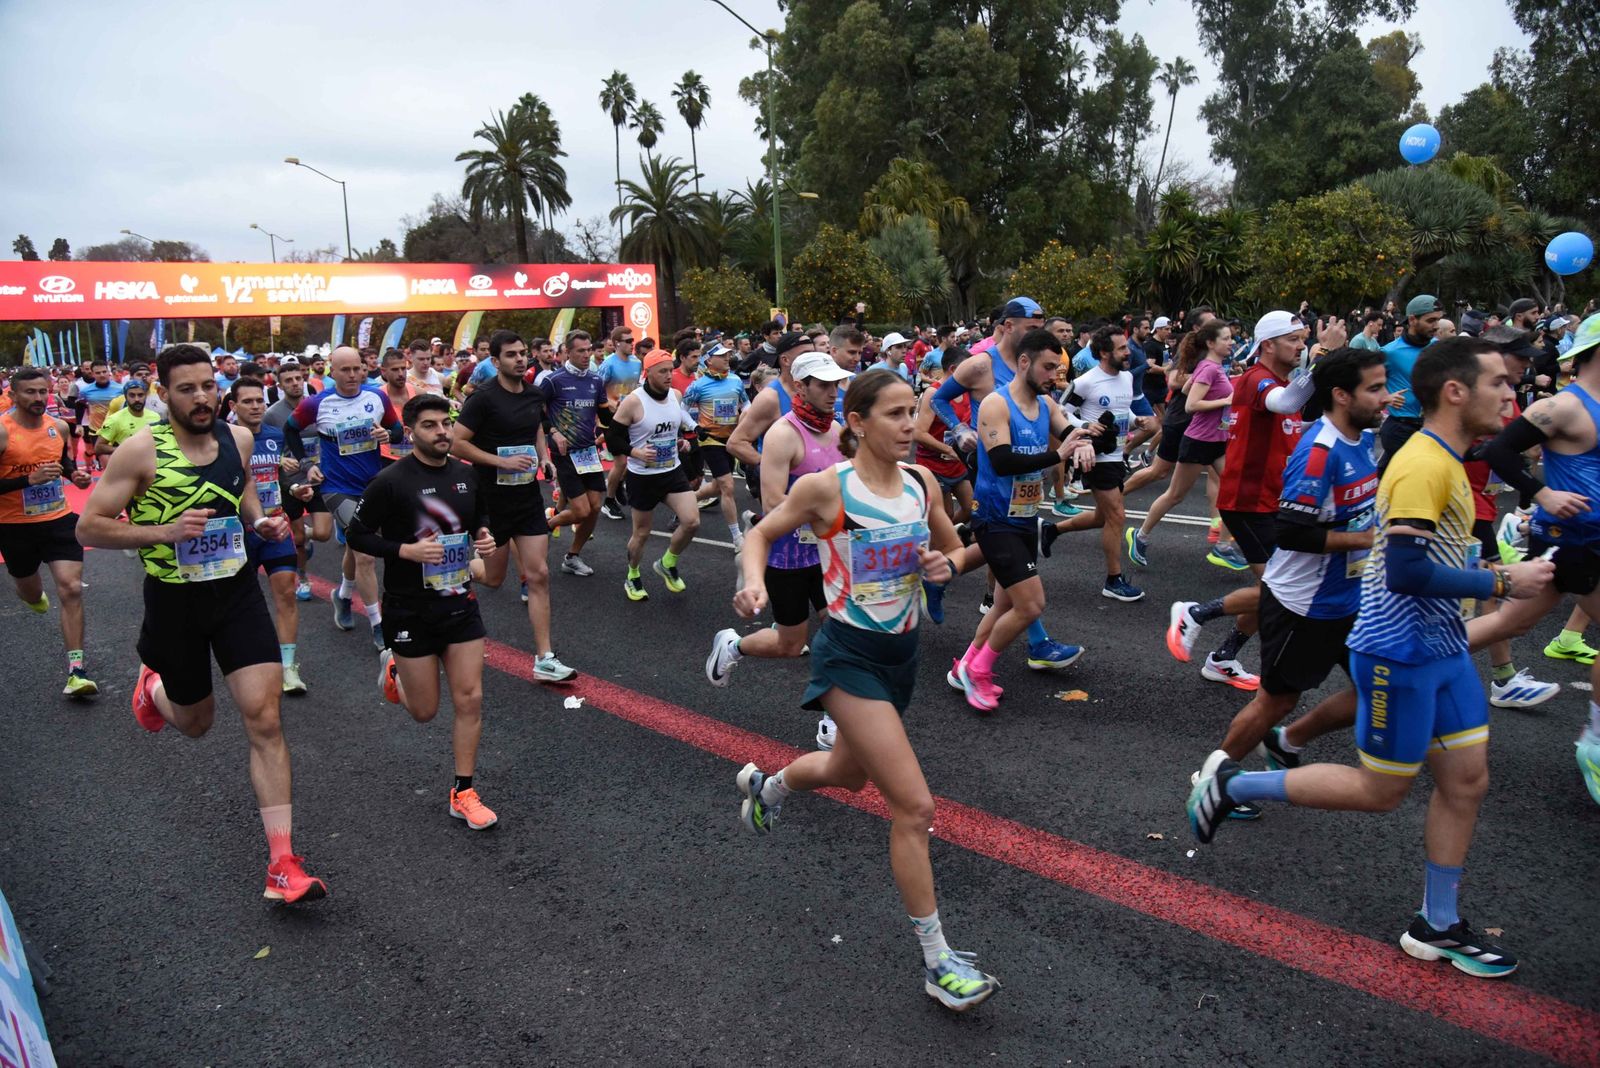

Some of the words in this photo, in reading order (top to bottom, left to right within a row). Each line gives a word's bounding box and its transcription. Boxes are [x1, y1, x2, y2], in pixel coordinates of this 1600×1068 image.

[0, 285, 26, 295] ter
[94, 281, 160, 300] HOKA
[411, 278, 458, 295] HOKA
[344, 427, 368, 440] 2966
[30, 486, 56, 500] 3631
[188, 532, 229, 555] 2554
[864, 541, 914, 571] 3127
[1371, 690, 1388, 729] CORIA
